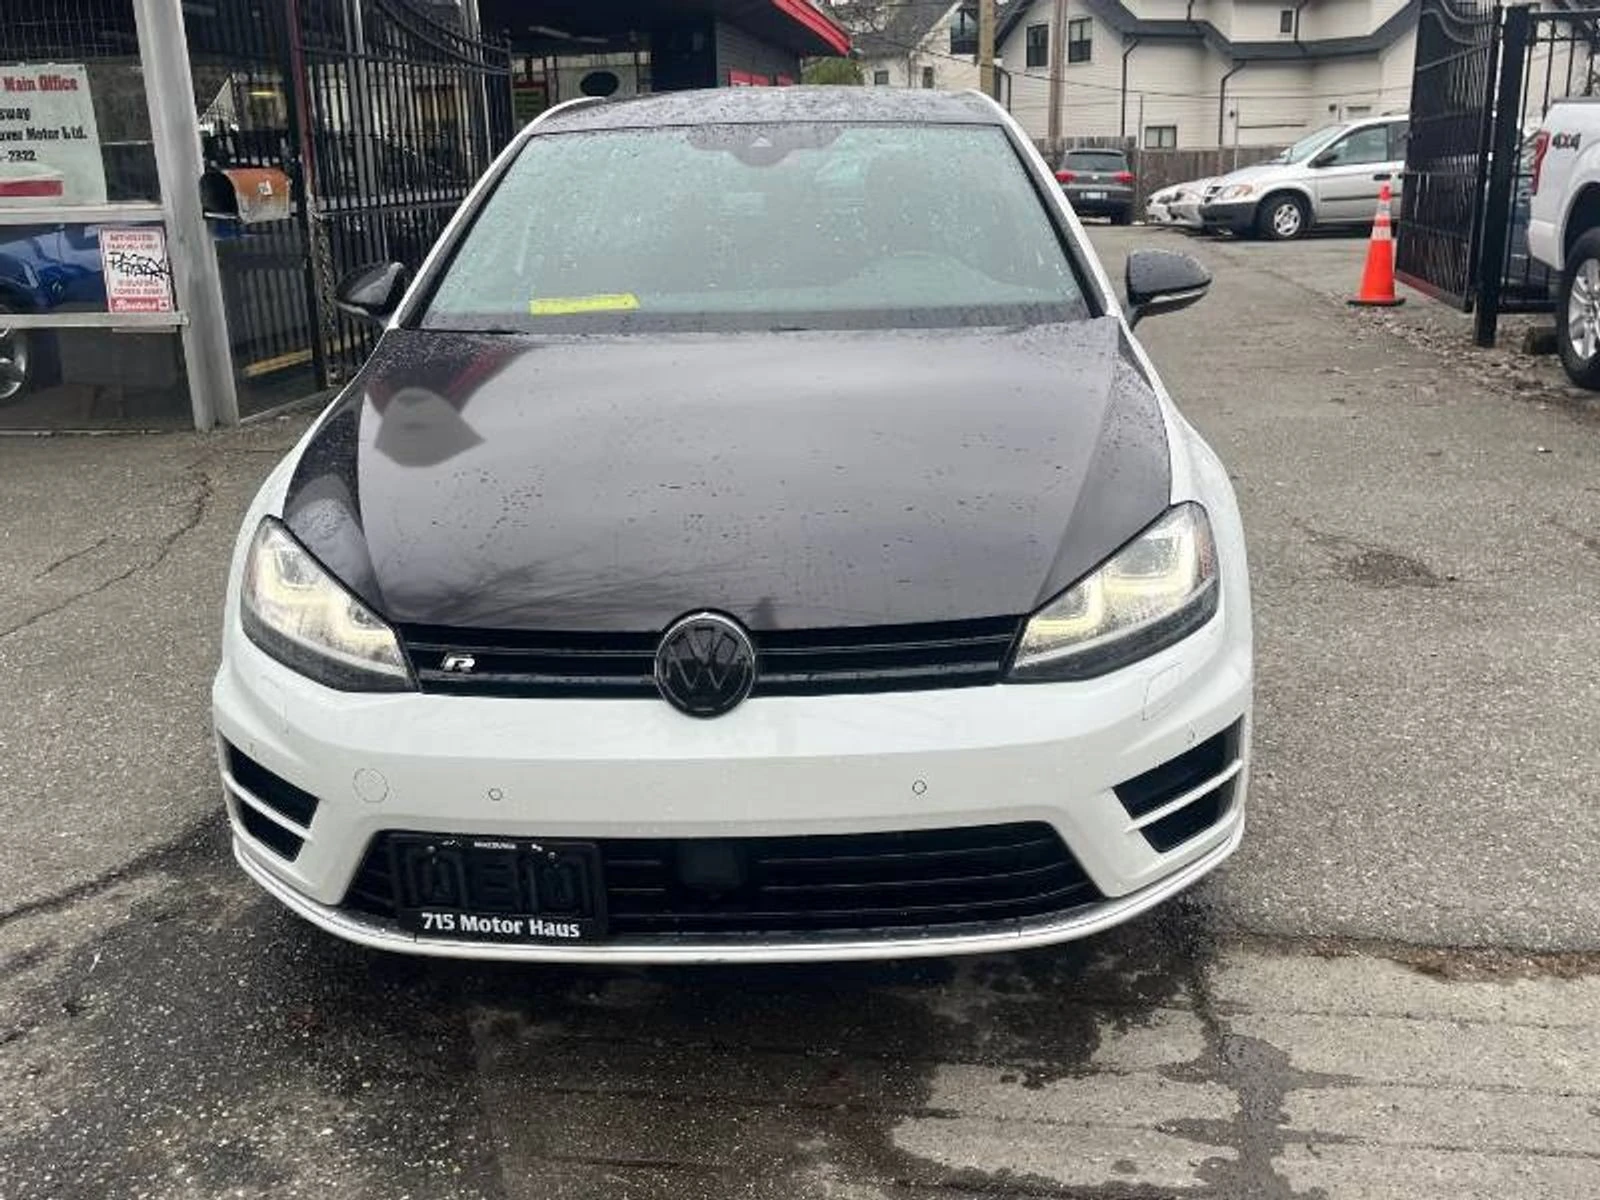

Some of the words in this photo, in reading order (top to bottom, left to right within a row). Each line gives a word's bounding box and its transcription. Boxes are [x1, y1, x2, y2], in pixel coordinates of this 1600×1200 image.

[3, 76, 36, 92] Main
[38, 75, 79, 91] Office
[26, 128, 60, 140] Motor
[442, 654, 476, 672] R
[421, 912, 454, 930] 715
[460, 914, 523, 934] Motor
[530, 919, 580, 938] Haus
